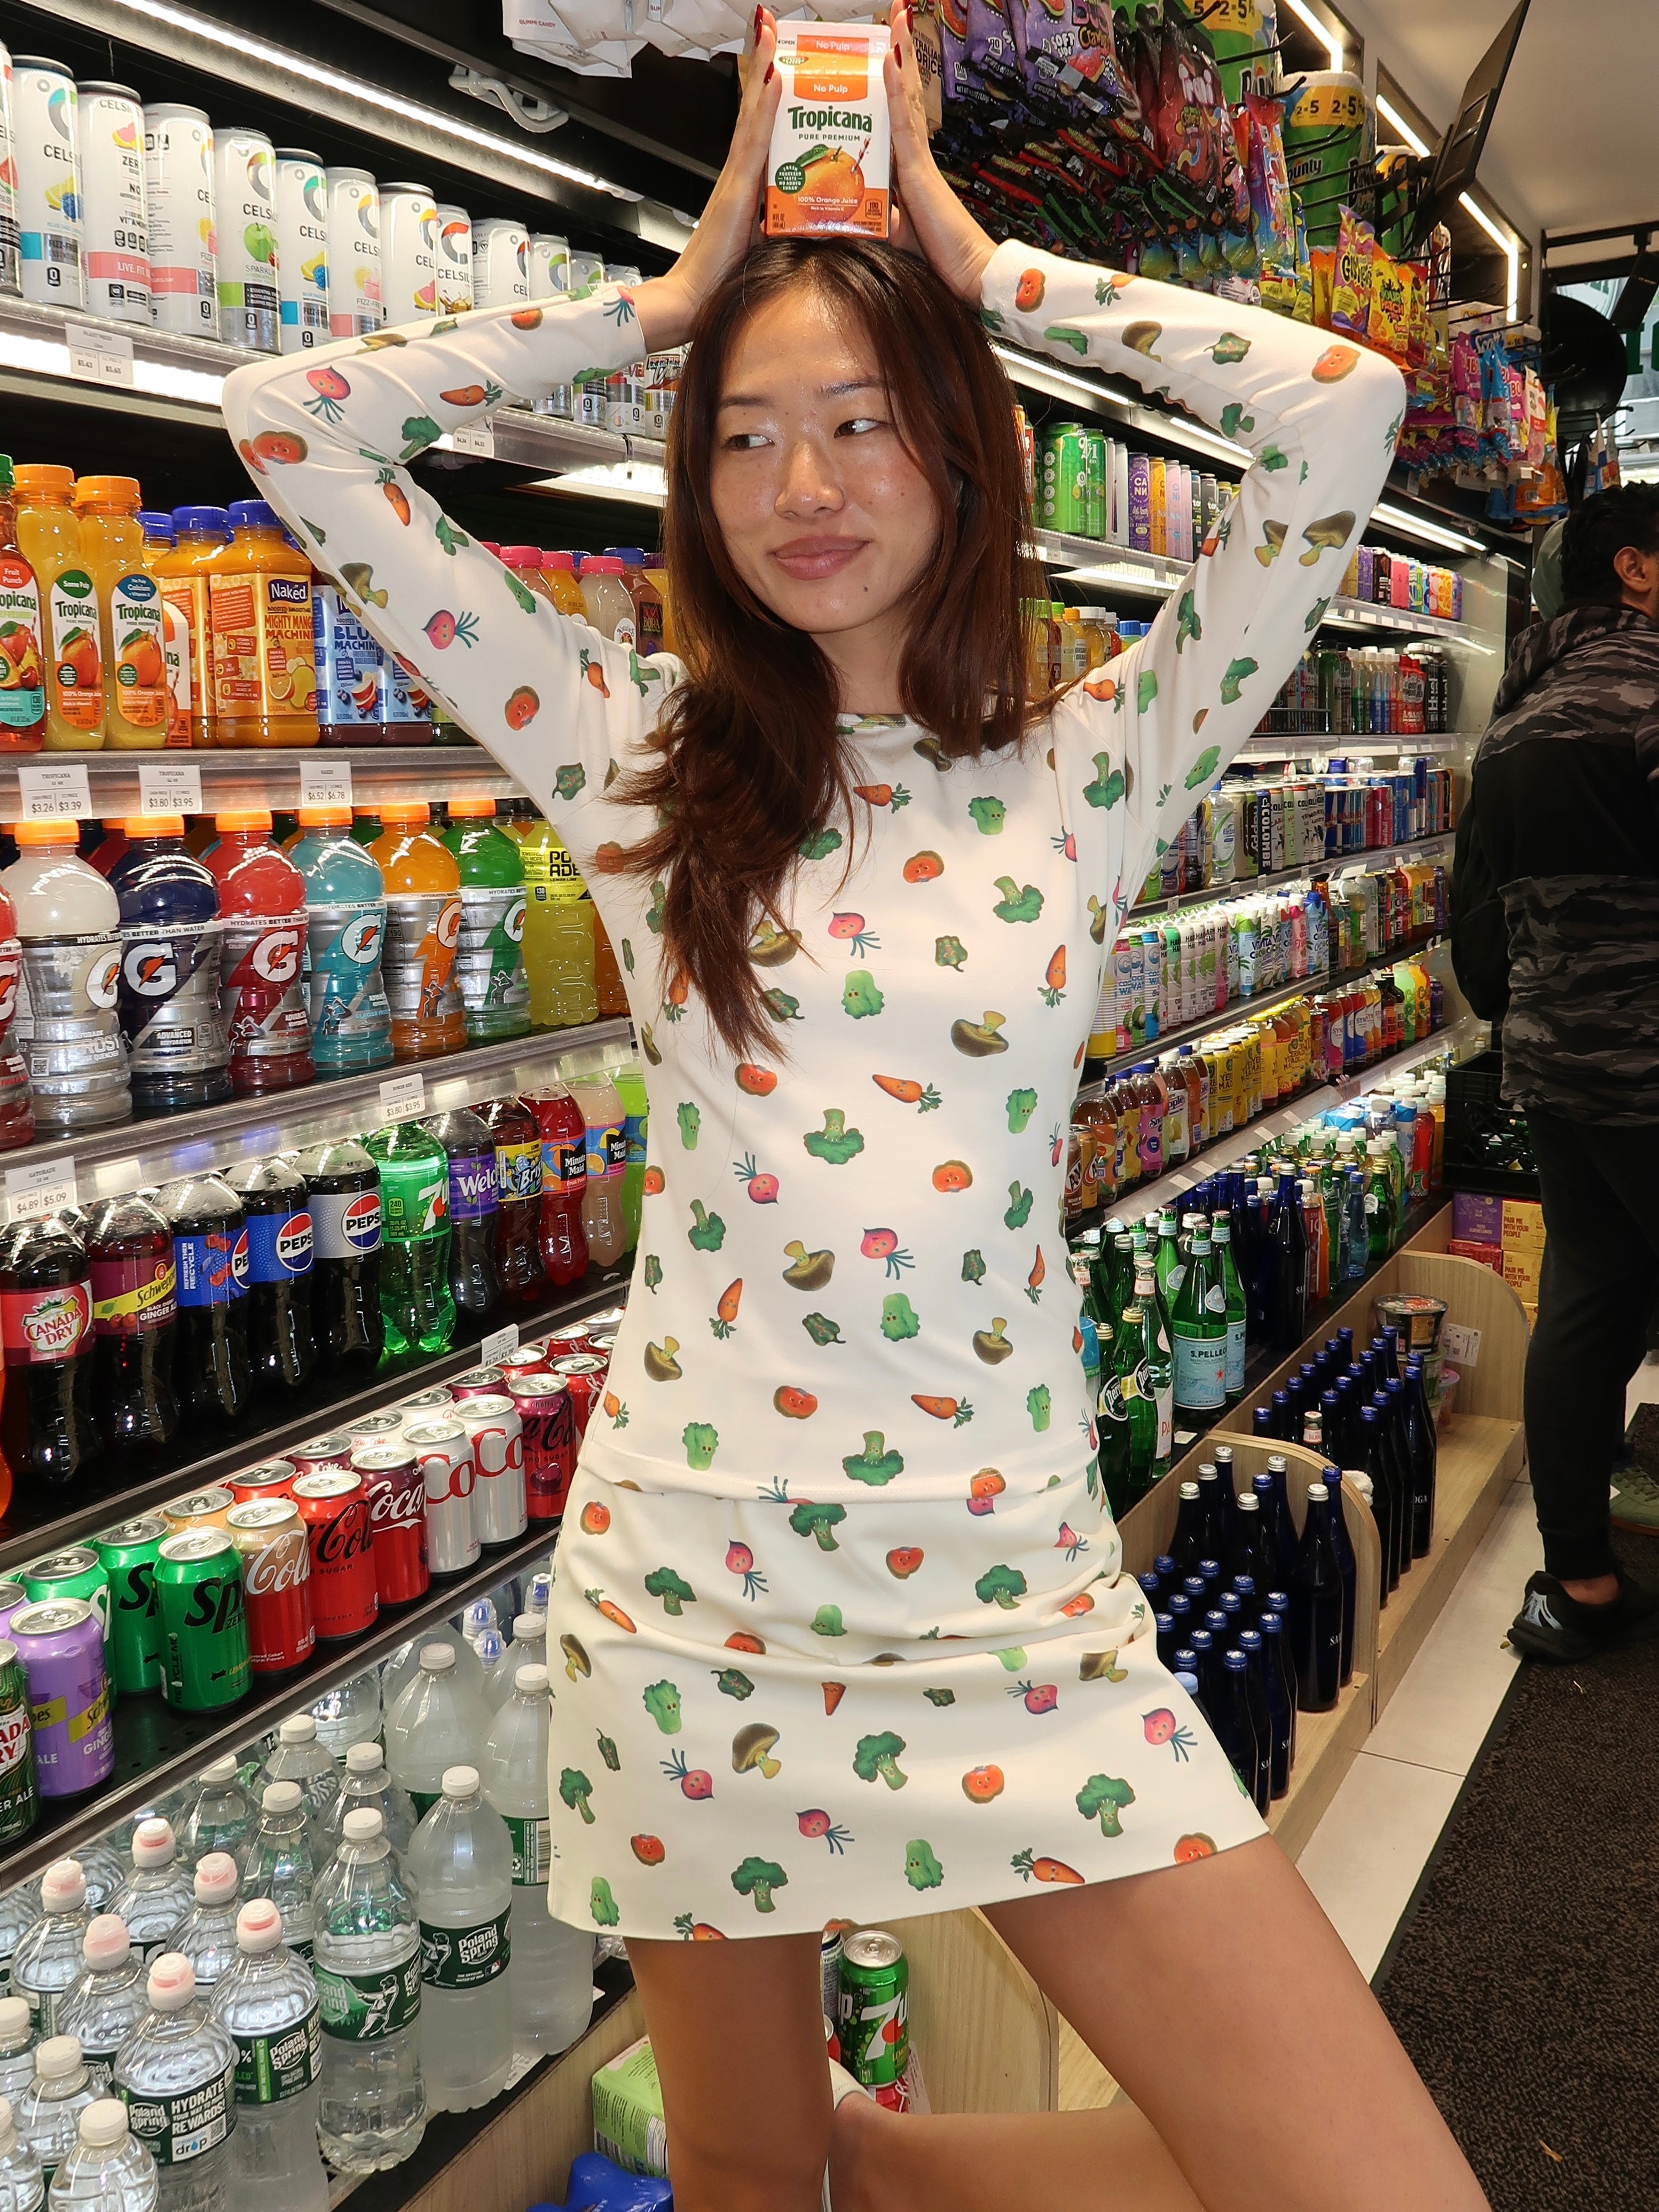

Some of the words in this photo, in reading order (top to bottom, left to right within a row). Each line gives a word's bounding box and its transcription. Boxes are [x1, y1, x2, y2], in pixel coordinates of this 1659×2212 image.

[816, 40, 828, 49] No
[830, 42, 850, 52] Pulp
[1051, 32, 1075, 50] SOFT
[813, 84, 827, 92] No
[829, 84, 848, 95] Pulp
[788, 105, 873, 133] Tropicana
[1287, 160, 1322, 182] ounty
[816, 197, 840, 205] Orange
[4, 567, 20, 576] Fruit
[3, 576, 23, 584] Punch
[63, 580, 78, 589] Some
[80, 581, 90, 591] Pulp
[271, 583, 308, 600] Naked
[0, 592, 37, 611] opicana
[55, 601, 98, 620] Tropicana
[116, 603, 161, 622] Tropicana
[265, 615, 292, 629] MIGHTY
[293, 615, 312, 629] MANG
[334, 640, 378, 650] MACHIN
[77, 691, 92, 699] Orange
[149, 798, 169, 807] $3.80
[173, 798, 194, 807] $3.95
[308, 791, 324, 801] $6.52
[327, 791, 345, 801] $6.78
[32, 803, 54, 813] $3.26
[59, 801, 82, 812] $3.39
[1261, 810, 1271, 868] COLOMBE
[77, 935, 107, 944] HYDRATES
[387, 1105, 403, 1117] $3.80
[405, 1100, 420, 1112] $3.95
[29, 1167, 56, 1178] GATORADE
[569, 1163, 585, 1175] Maid
[17, 1199, 39, 1214] $4.89
[44, 1192, 67, 1206] $5.09
[390, 1199, 402, 1208] 240
[346, 1211, 381, 1231] PEPS
[1504, 1216, 1516, 1224] PAIR
[1503, 1230, 1521, 1238] PEOPLE
[1516, 1224, 1529, 1232] YOUR
[280, 1232, 313, 1253] PEPS
[147, 1303, 161, 1312] BLACK
[140, 1308, 170, 1321] GINGER
[25, 1306, 83, 1342] CANADA
[45, 1323, 73, 1347] DRY
[319, 1563, 353, 1576] SUGAR
[15, 1786, 34, 1806] ALE
[459, 1924, 498, 1952] Poland
[460, 1935, 499, 1965] Spring
[269, 2027, 306, 2060] Poland
[272, 2037, 309, 2070] Spring
[171, 2098, 226, 2136] REWARDS!
